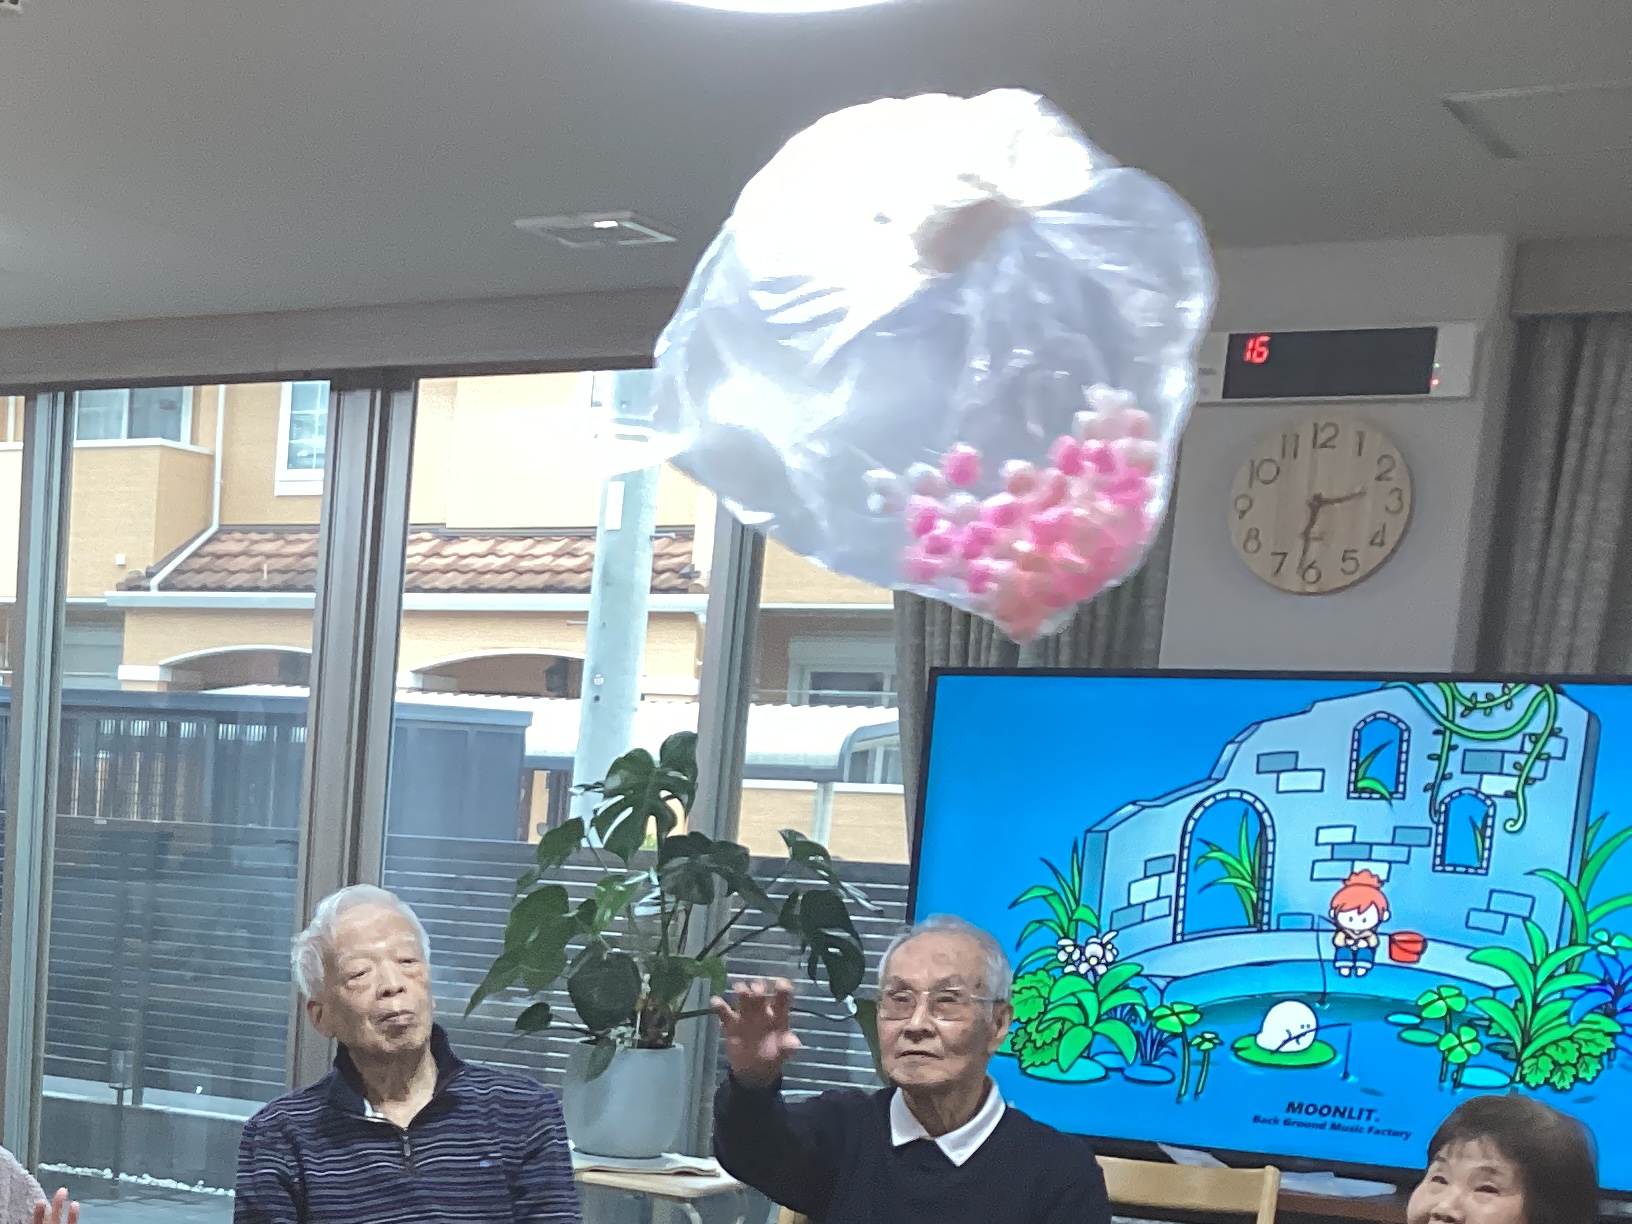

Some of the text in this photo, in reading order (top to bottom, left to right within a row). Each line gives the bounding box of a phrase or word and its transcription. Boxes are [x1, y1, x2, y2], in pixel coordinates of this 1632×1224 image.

[1281, 433, 1300, 459] 11
[1312, 422, 1339, 450] 12
[1356, 431, 1365, 457] 1
[1248, 458, 1280, 488] 10
[1374, 454, 1397, 482] 2
[1234, 494, 1253, 520] 9
[1384, 488, 1404, 515] 3
[1242, 528, 1262, 554] 8
[1370, 523, 1387, 548] 4
[1271, 552, 1288, 576] 7
[1301, 560, 1322, 585] 6
[1340, 550, 1360, 576] 5
[1285, 1101, 1381, 1122] MOONLIT.
[1252, 1115, 1412, 1141] Back Ground Music Factory
